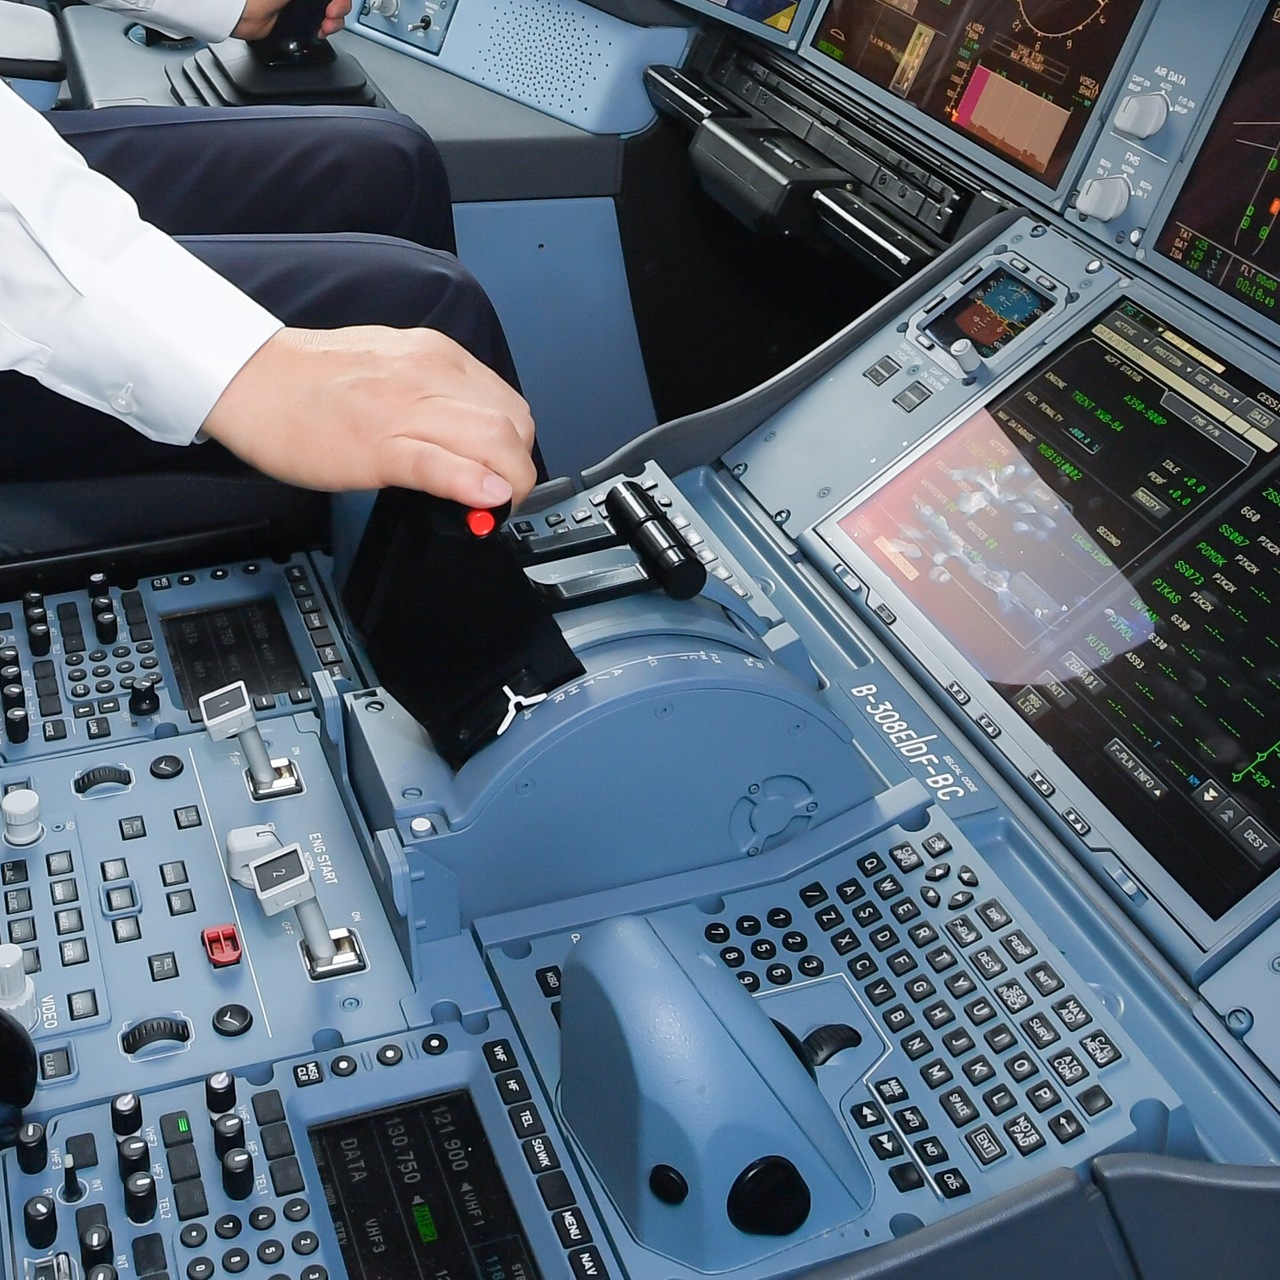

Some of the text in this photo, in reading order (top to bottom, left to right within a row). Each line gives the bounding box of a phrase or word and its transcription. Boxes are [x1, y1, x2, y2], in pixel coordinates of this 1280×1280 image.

[1154, 65, 1187, 87] AIR DATA
[1124, 152, 1141, 166] FMS
[1195, 541, 1228, 568] POMOK
[1151, 577, 1182, 606] PIKAS
[961, 776, 979, 793] CODE
[1243, 827, 1268, 853] DEST
[308, 832, 339, 885] ENG START
[1007, 935, 1030, 957] PERF
[977, 951, 998, 973] DEST
[1035, 970, 1052, 987] INIT
[40, 995, 59, 1029] VIDEO
[1029, 1018, 1052, 1041] SURV
[1083, 1038, 1109, 1064] MENU
[949, 1093, 970, 1118] SPACE
[1010, 1125, 1030, 1147] PAD
[1016, 1116, 1040, 1144] NOTE
[976, 1134, 997, 1155] ENT
[560, 1211, 583, 1242] MENU
[579, 1254, 599, 1276] NAV
